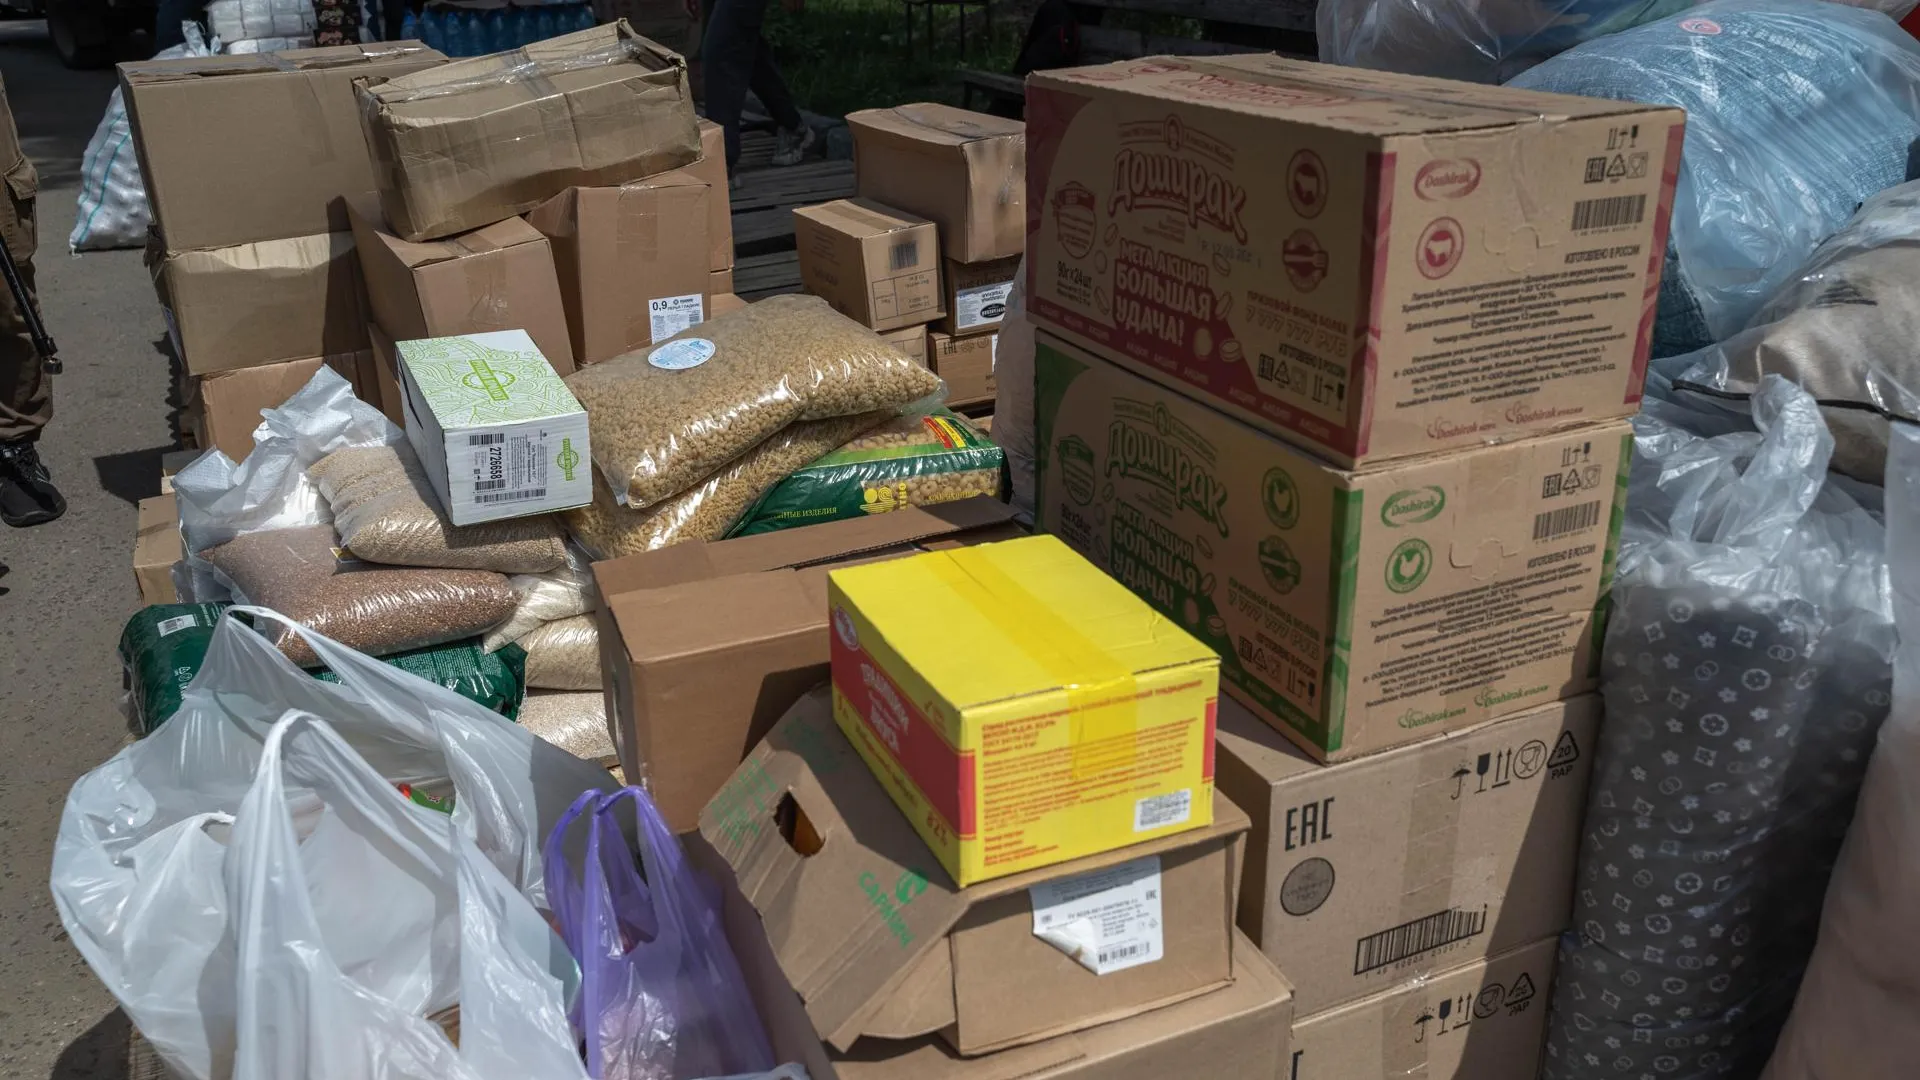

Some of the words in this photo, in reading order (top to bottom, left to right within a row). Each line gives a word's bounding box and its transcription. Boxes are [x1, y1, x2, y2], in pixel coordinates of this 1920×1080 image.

[1108, 149, 1248, 246] Доширак
[1115, 259, 1212, 322] БОЛЬШАЯ
[1159, 246, 1210, 289] АКЦИЯ
[652, 300, 668, 311] 0,9
[1114, 293, 1185, 346] УДАЧА!
[489, 447, 503, 480] 2726658
[1104, 420, 1229, 538] Доширак
[802, 507, 837, 518] ИЗДЕЛИЯ
[1112, 519, 1198, 595] БОЛЬШАЯ
[1113, 551, 1174, 610] УДАЧА!
[1551, 765, 1574, 780] PAP
[1285, 796, 1335, 852] EAC
[1508, 1001, 1530, 1016] PAP
